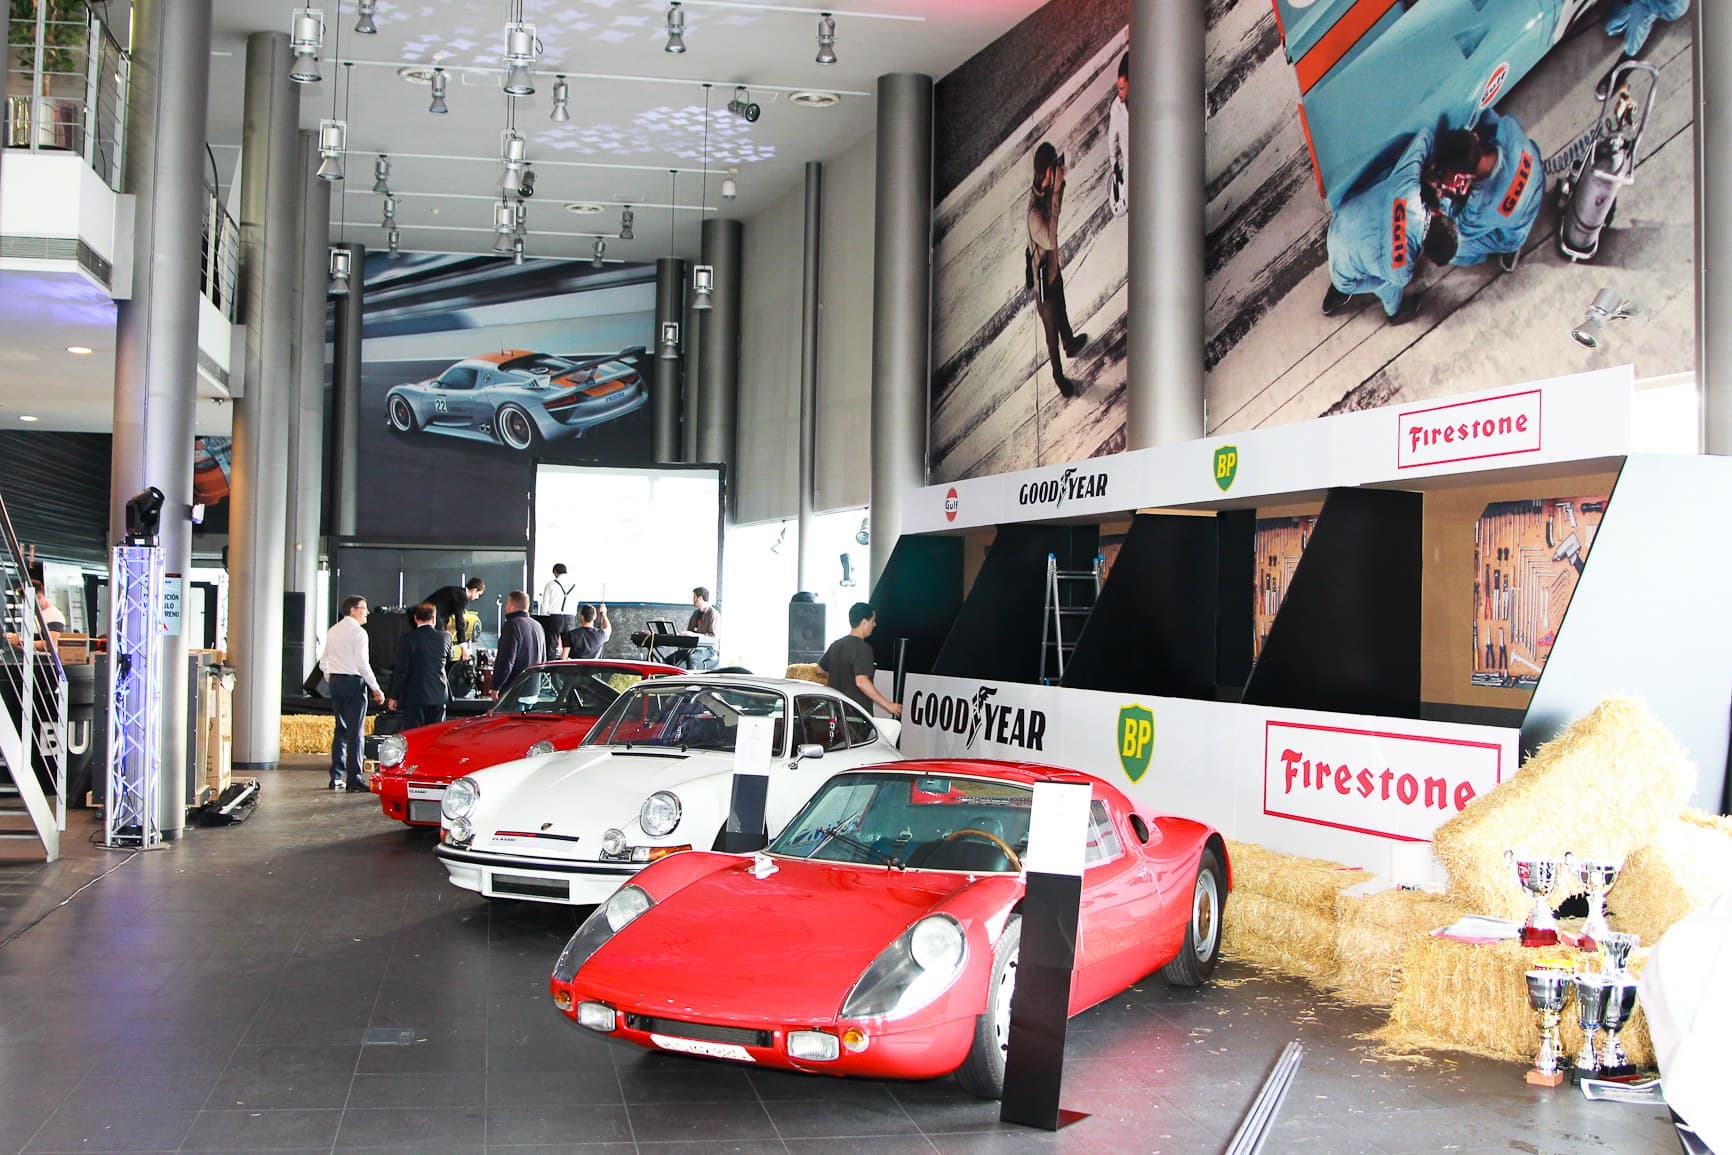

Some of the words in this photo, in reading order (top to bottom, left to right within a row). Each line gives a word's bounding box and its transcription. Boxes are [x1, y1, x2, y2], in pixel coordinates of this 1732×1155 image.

[1502, 154, 1531, 213] Gulf
[1394, 202, 1406, 263] Gulf
[436, 400, 447, 412] 22
[1409, 413, 1529, 453] Firestone
[1216, 452, 1236, 479] BP
[945, 499, 959, 510] Gulf
[1122, 717, 1152, 760] BP
[1280, 748, 1477, 813] Firestone
